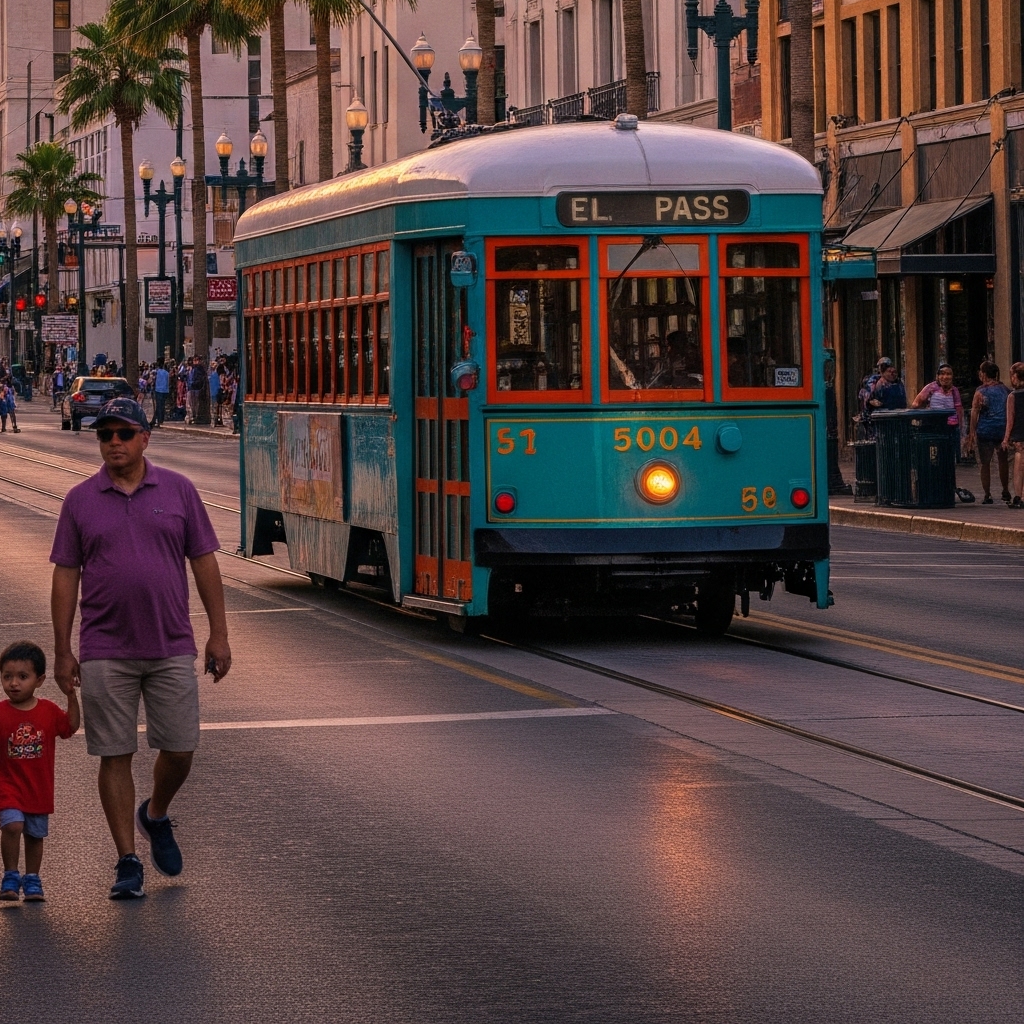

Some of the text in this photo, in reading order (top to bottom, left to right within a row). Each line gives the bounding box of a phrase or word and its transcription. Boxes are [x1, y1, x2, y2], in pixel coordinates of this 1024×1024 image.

[655, 195, 729, 221] PASS
[497, 427, 537, 455] 51
[614, 426, 703, 452] 5004
